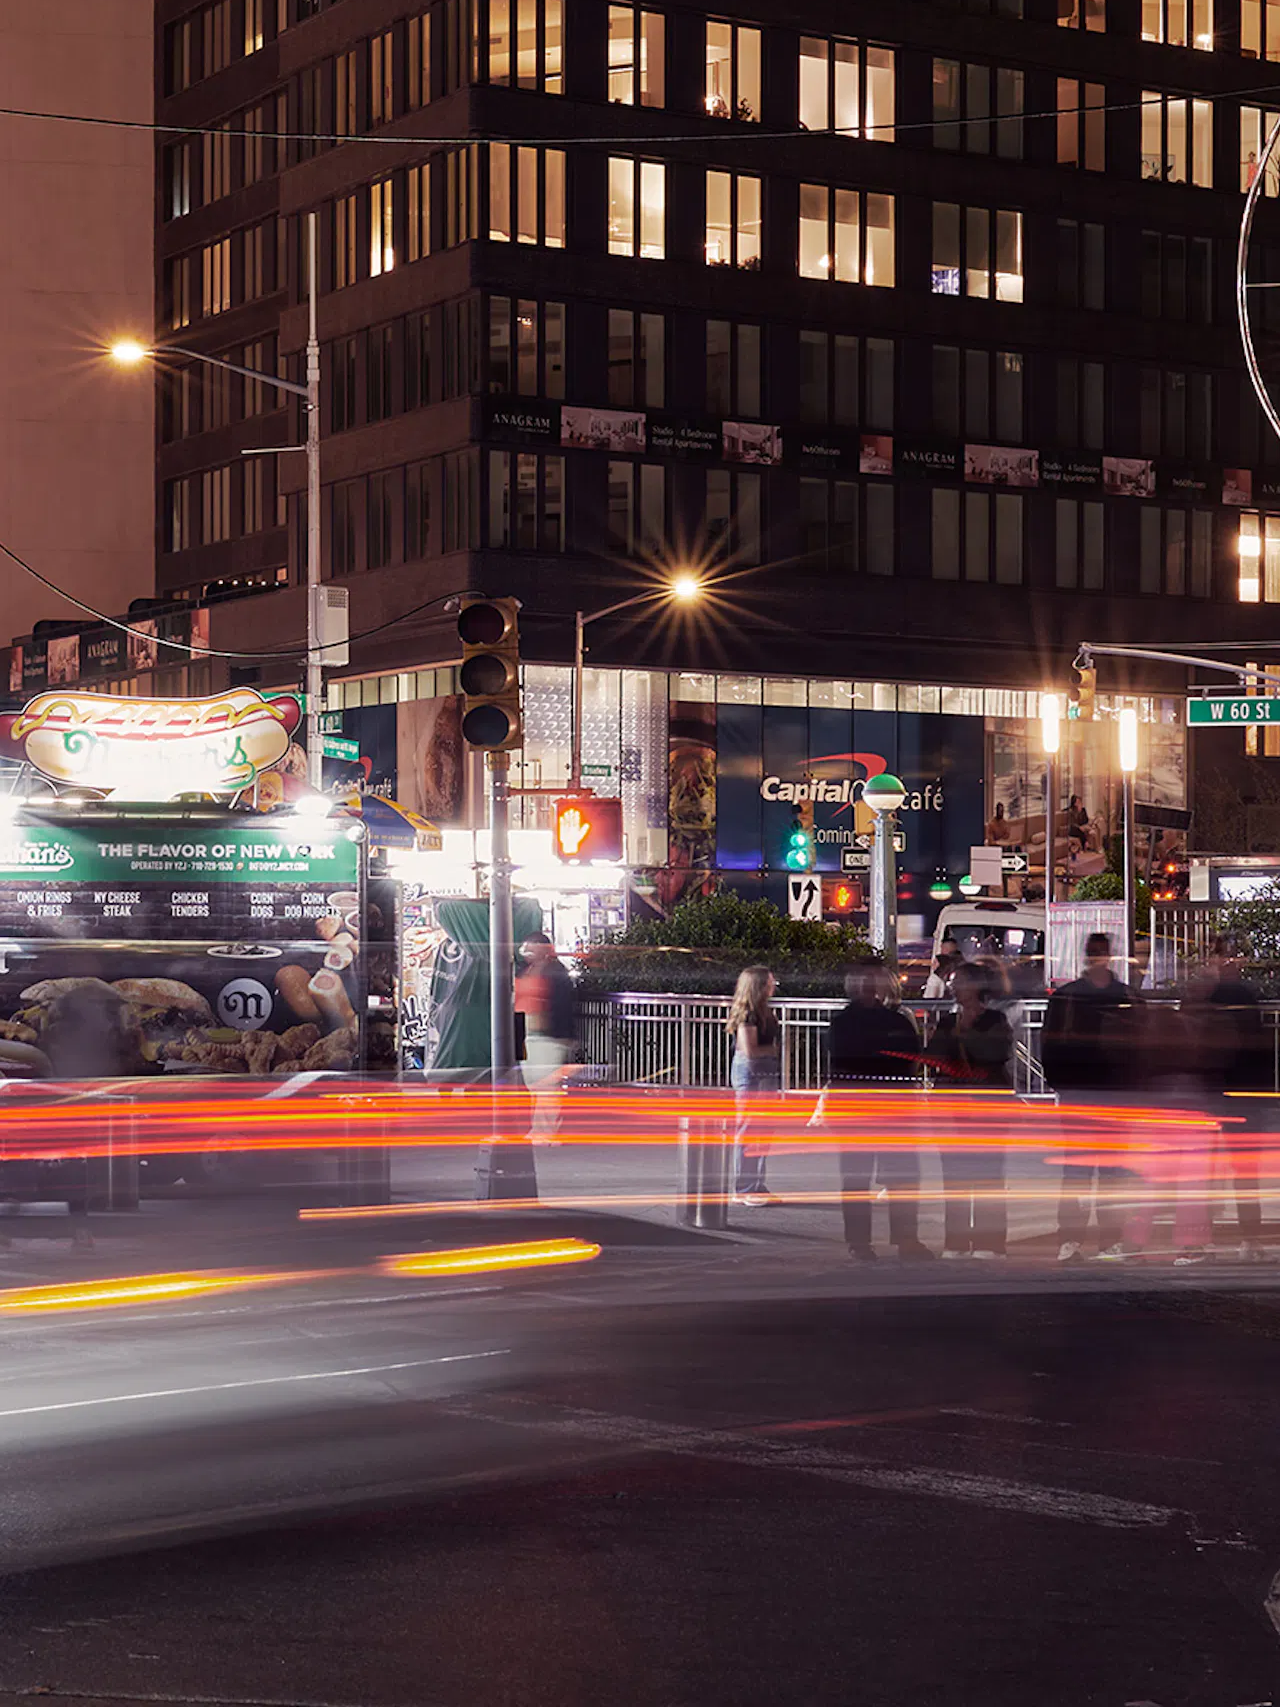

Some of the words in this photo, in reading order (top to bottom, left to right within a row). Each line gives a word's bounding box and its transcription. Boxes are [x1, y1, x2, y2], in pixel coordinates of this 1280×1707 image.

[492, 413, 550, 428] ANAGRAM
[901, 450, 956, 464] ANAGRAM
[1210, 703, 1226, 719] W
[1230, 703, 1250, 720] 60
[1255, 703, 1271, 719] St
[760, 776, 850, 805] Capital
[901, 784, 945, 812] café
[98, 843, 133, 858] THE
[137, 843, 207, 858] FLAVOR
[211, 843, 236, 858] OF
[240, 843, 283, 859] NEW
[16, 891, 44, 903] ONION
[45, 891, 72, 903] RINGS
[94, 892, 108, 904] NY
[108, 892, 141, 904] CHEESE
[171, 891, 209, 904] CHICKEN
[250, 892, 274, 904] CORN
[301, 892, 325, 904] CORN
[27, 905, 36, 917] &
[37, 905, 63, 917] FRIES
[103, 905, 132, 917] STEAK
[170, 904, 210, 917] TENDERS
[250, 904, 274, 918] DOGS
[284, 904, 302, 917] DOG
[302, 904, 342, 918] NUGGETS
